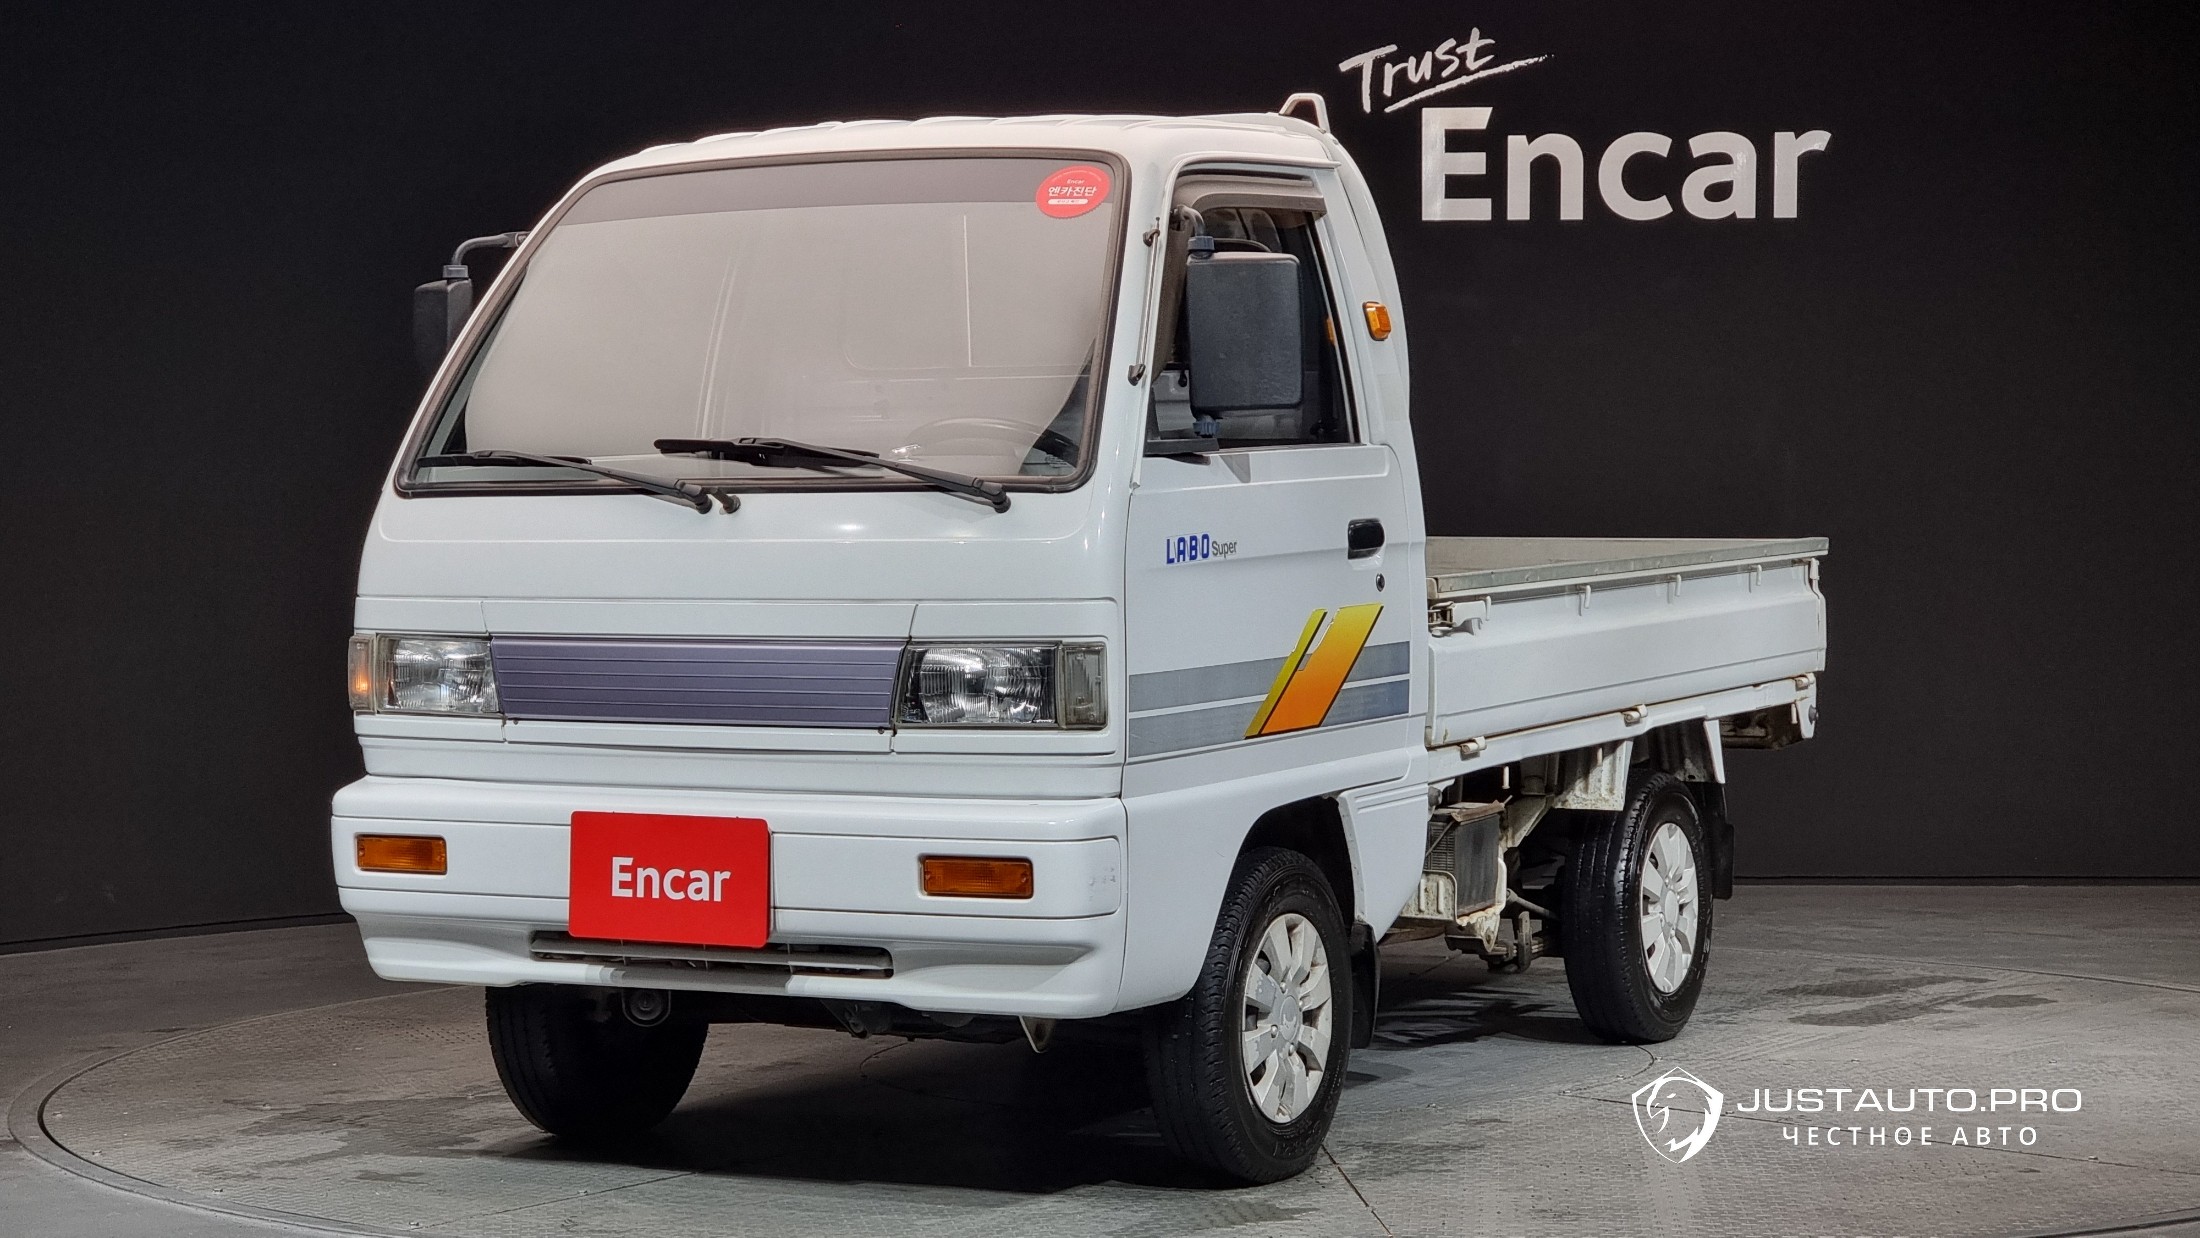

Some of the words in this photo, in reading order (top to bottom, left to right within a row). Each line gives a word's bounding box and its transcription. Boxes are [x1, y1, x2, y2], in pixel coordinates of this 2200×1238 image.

[1338, 27, 1497, 113] Trust
[1421, 106, 1832, 221] Encar
[1048, 186, 1097, 197] 엔카진단
[1166, 533, 1210, 564] LABO
[1211, 540, 1237, 558] Super
[611, 856, 731, 902] Encar
